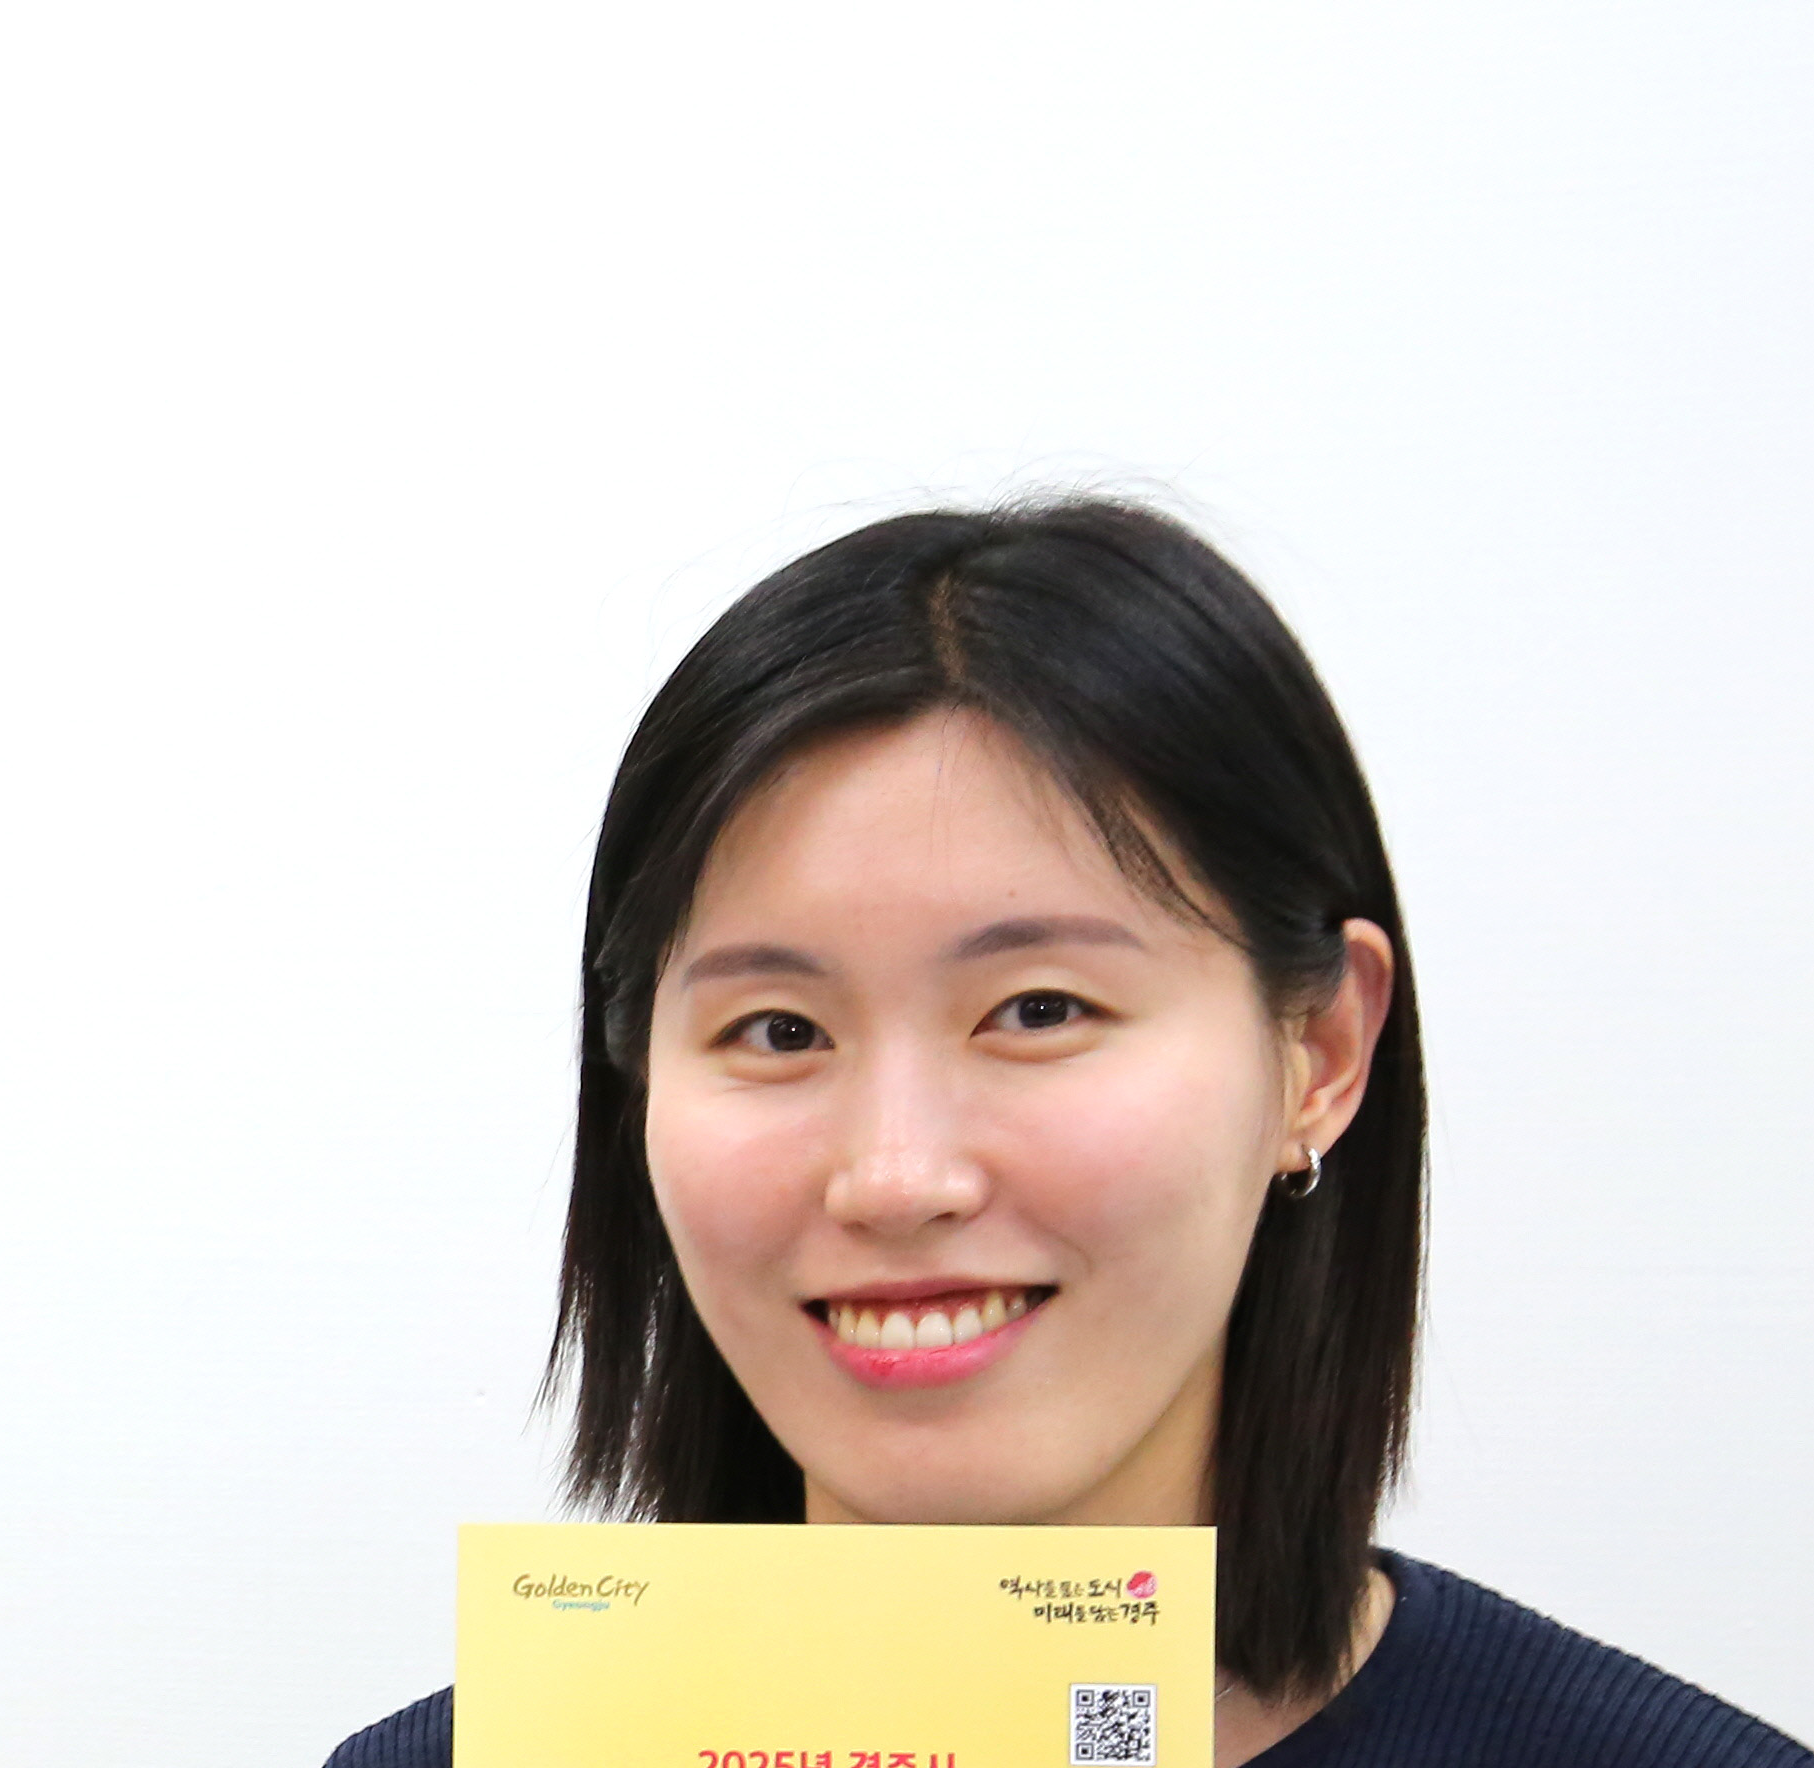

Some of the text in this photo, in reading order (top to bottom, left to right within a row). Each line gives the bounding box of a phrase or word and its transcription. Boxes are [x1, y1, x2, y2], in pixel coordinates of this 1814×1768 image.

[513, 1573, 650, 1606] Golden City
[1120, 1601, 1160, 1626] 경주
